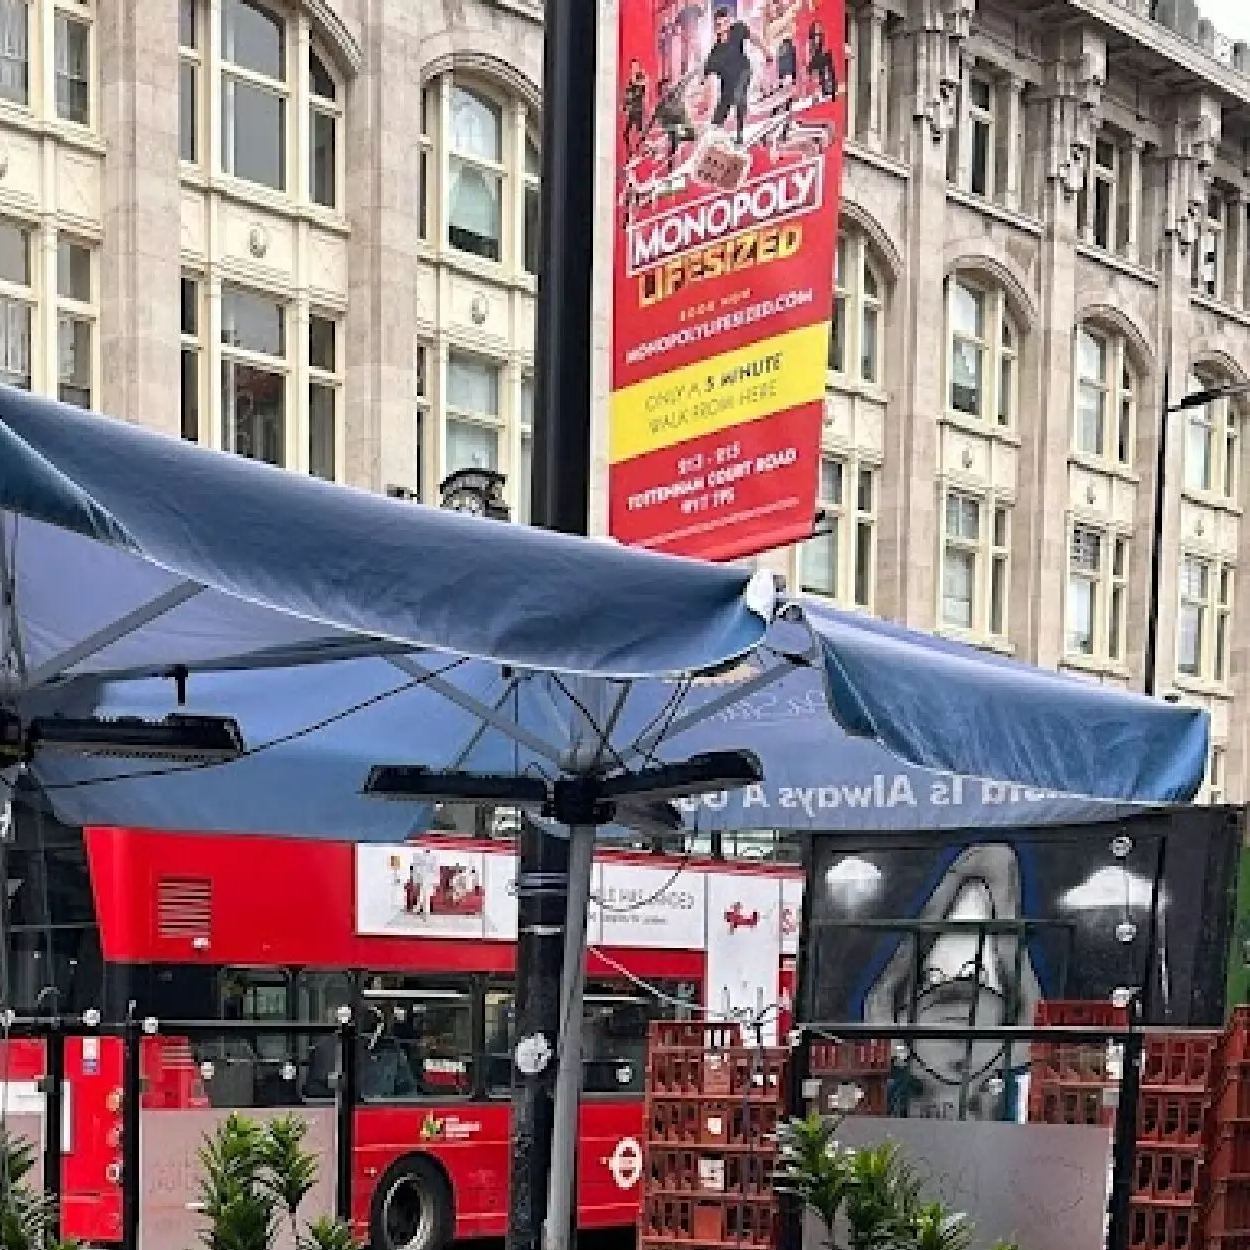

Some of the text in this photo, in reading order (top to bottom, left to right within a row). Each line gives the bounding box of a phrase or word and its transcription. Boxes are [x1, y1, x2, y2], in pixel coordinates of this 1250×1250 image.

[636, 172, 814, 262] MONOPOLY
[638, 225, 803, 308] LIFESIZED
[644, 384, 686, 412] ONLY
[687, 382, 702, 398] A
[720, 351, 783, 386] MINUTE
[692, 394, 735, 421] FROM
[739, 378, 778, 405] HERE
[626, 447, 798, 511] TOTTENHAM COURT ROAD
